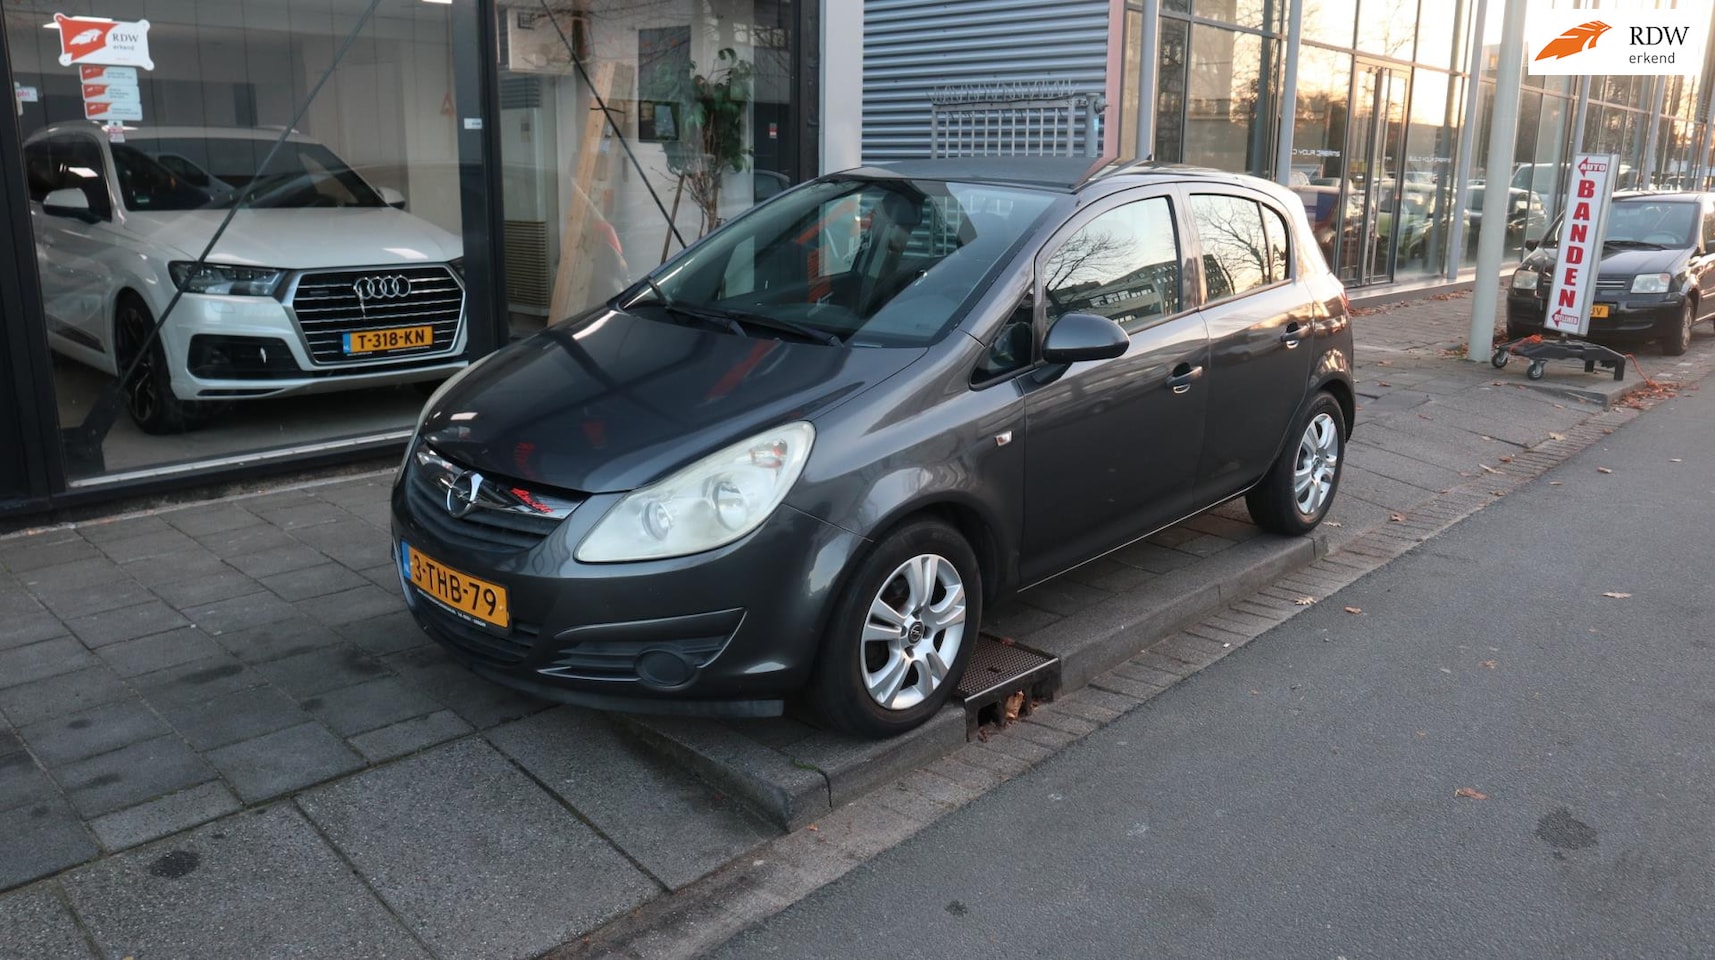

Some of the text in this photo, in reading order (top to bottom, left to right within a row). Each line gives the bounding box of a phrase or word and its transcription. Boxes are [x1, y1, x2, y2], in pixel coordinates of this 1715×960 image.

[112, 33, 139, 43] RDW
[1580, 163, 1606, 172] AUTO
[1558, 179, 1596, 308] BANDEN
[358, 330, 425, 350] T-318-KN
[414, 554, 497, 617] 3-THB-79
